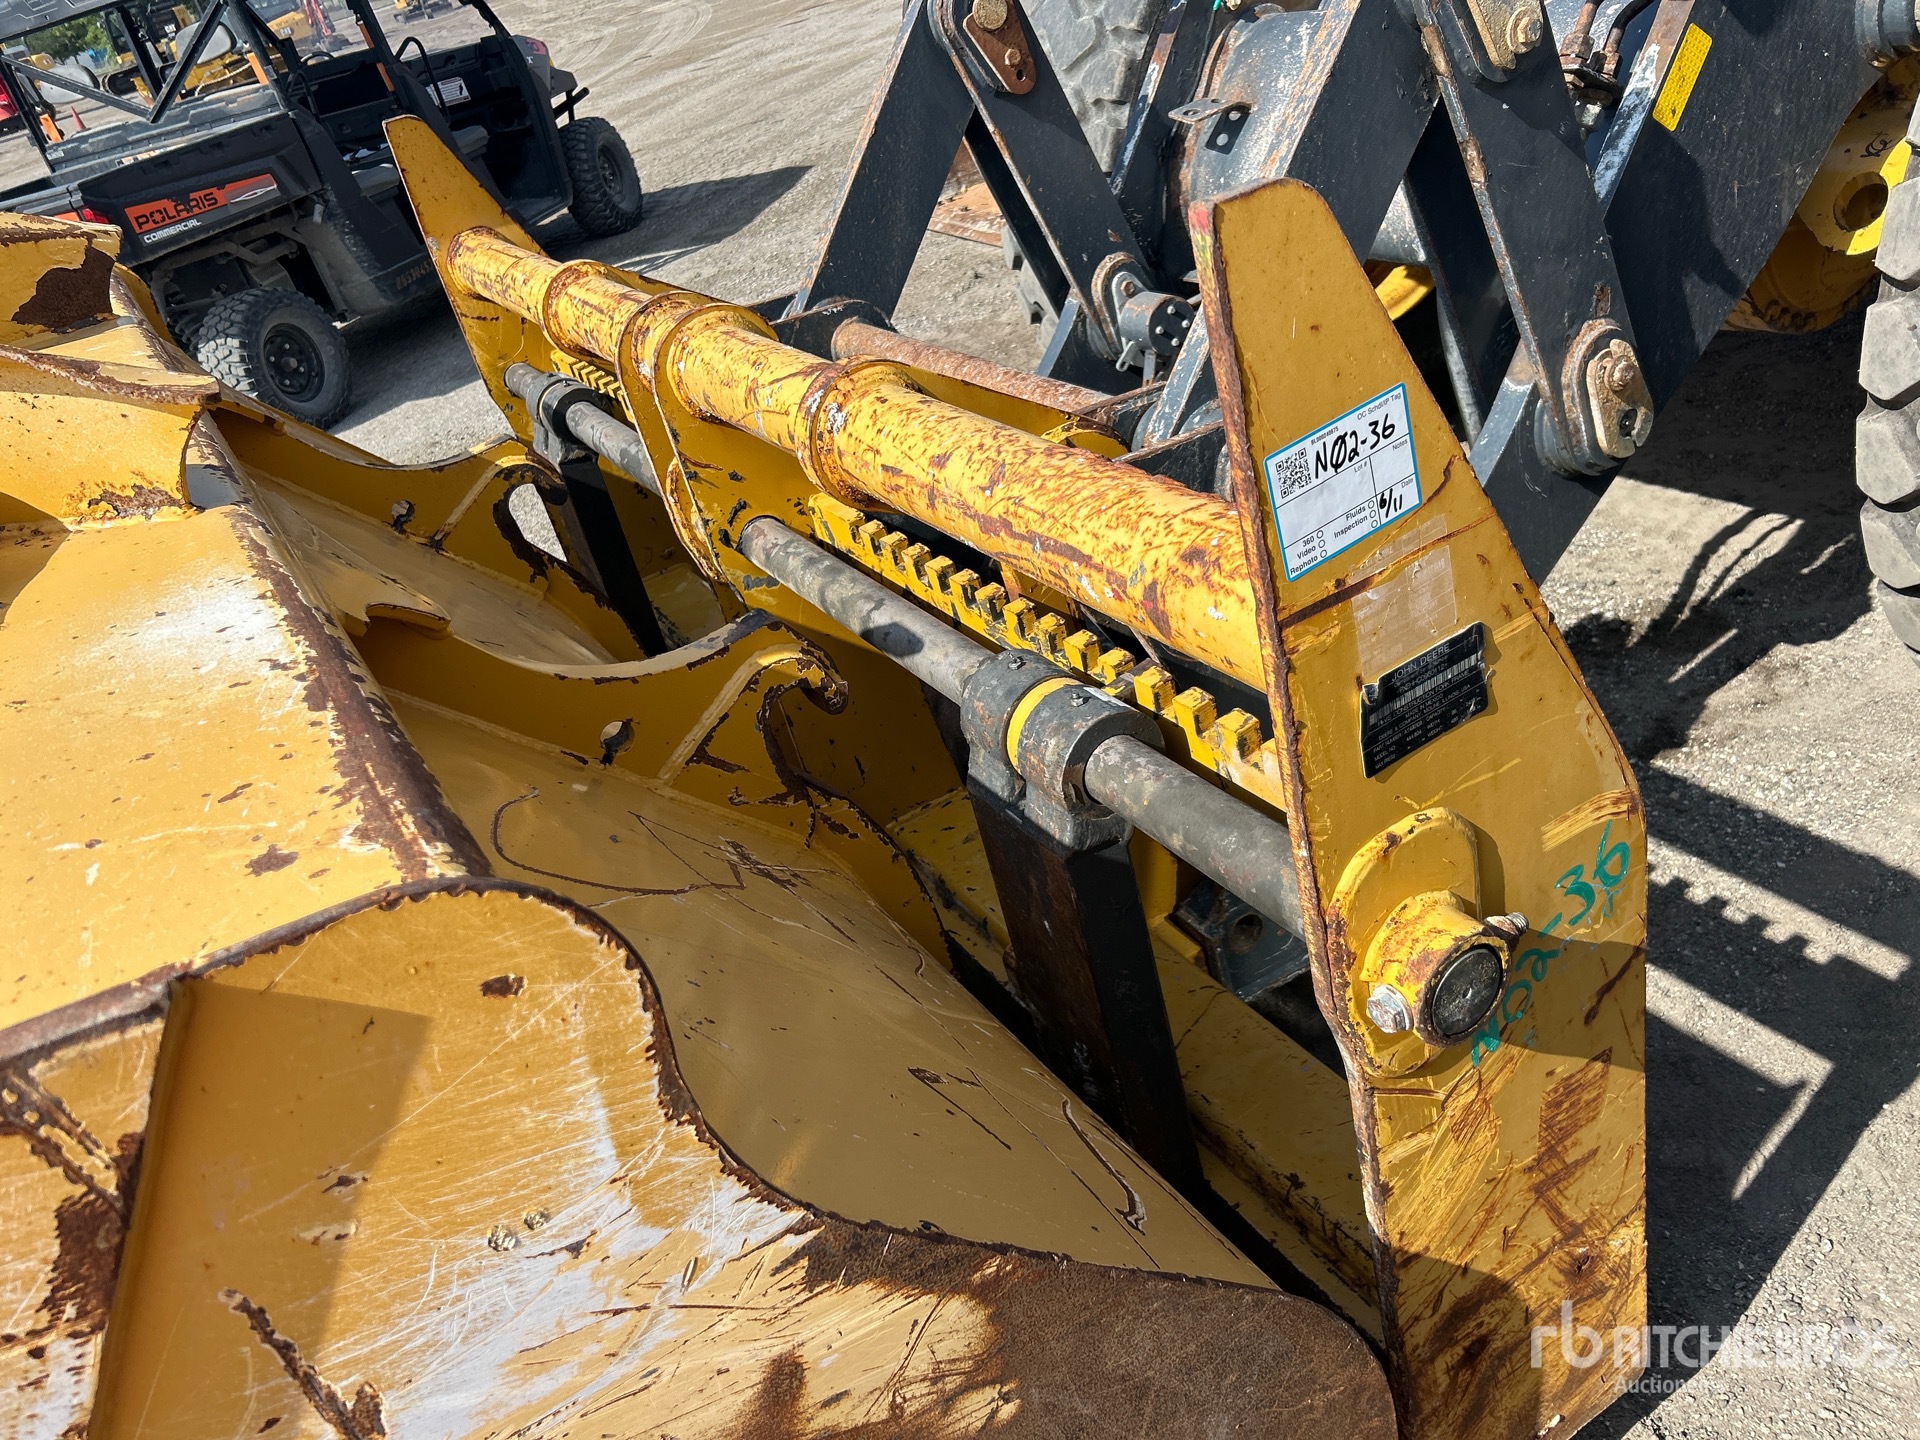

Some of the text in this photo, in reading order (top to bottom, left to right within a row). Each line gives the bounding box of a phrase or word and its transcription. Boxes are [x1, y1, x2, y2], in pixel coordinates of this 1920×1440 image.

[134, 191, 219, 231] POLARIS
[143, 218, 202, 244] COMMERCIAL
[1392, 439, 1408, 451] Notes
[1401, 478, 1414, 488] Date
[1379, 488, 1403, 518] 6/11
[1345, 506, 1366, 521] Fluids
[1333, 515, 1368, 539] Inspection
[1302, 535, 1315, 547] 360
[1297, 545, 1316, 560] Video
[1290, 555, 1318, 575] Rephoto
[1392, 662, 1417, 681] JOHN
[1420, 643, 1450, 666] DEERE
